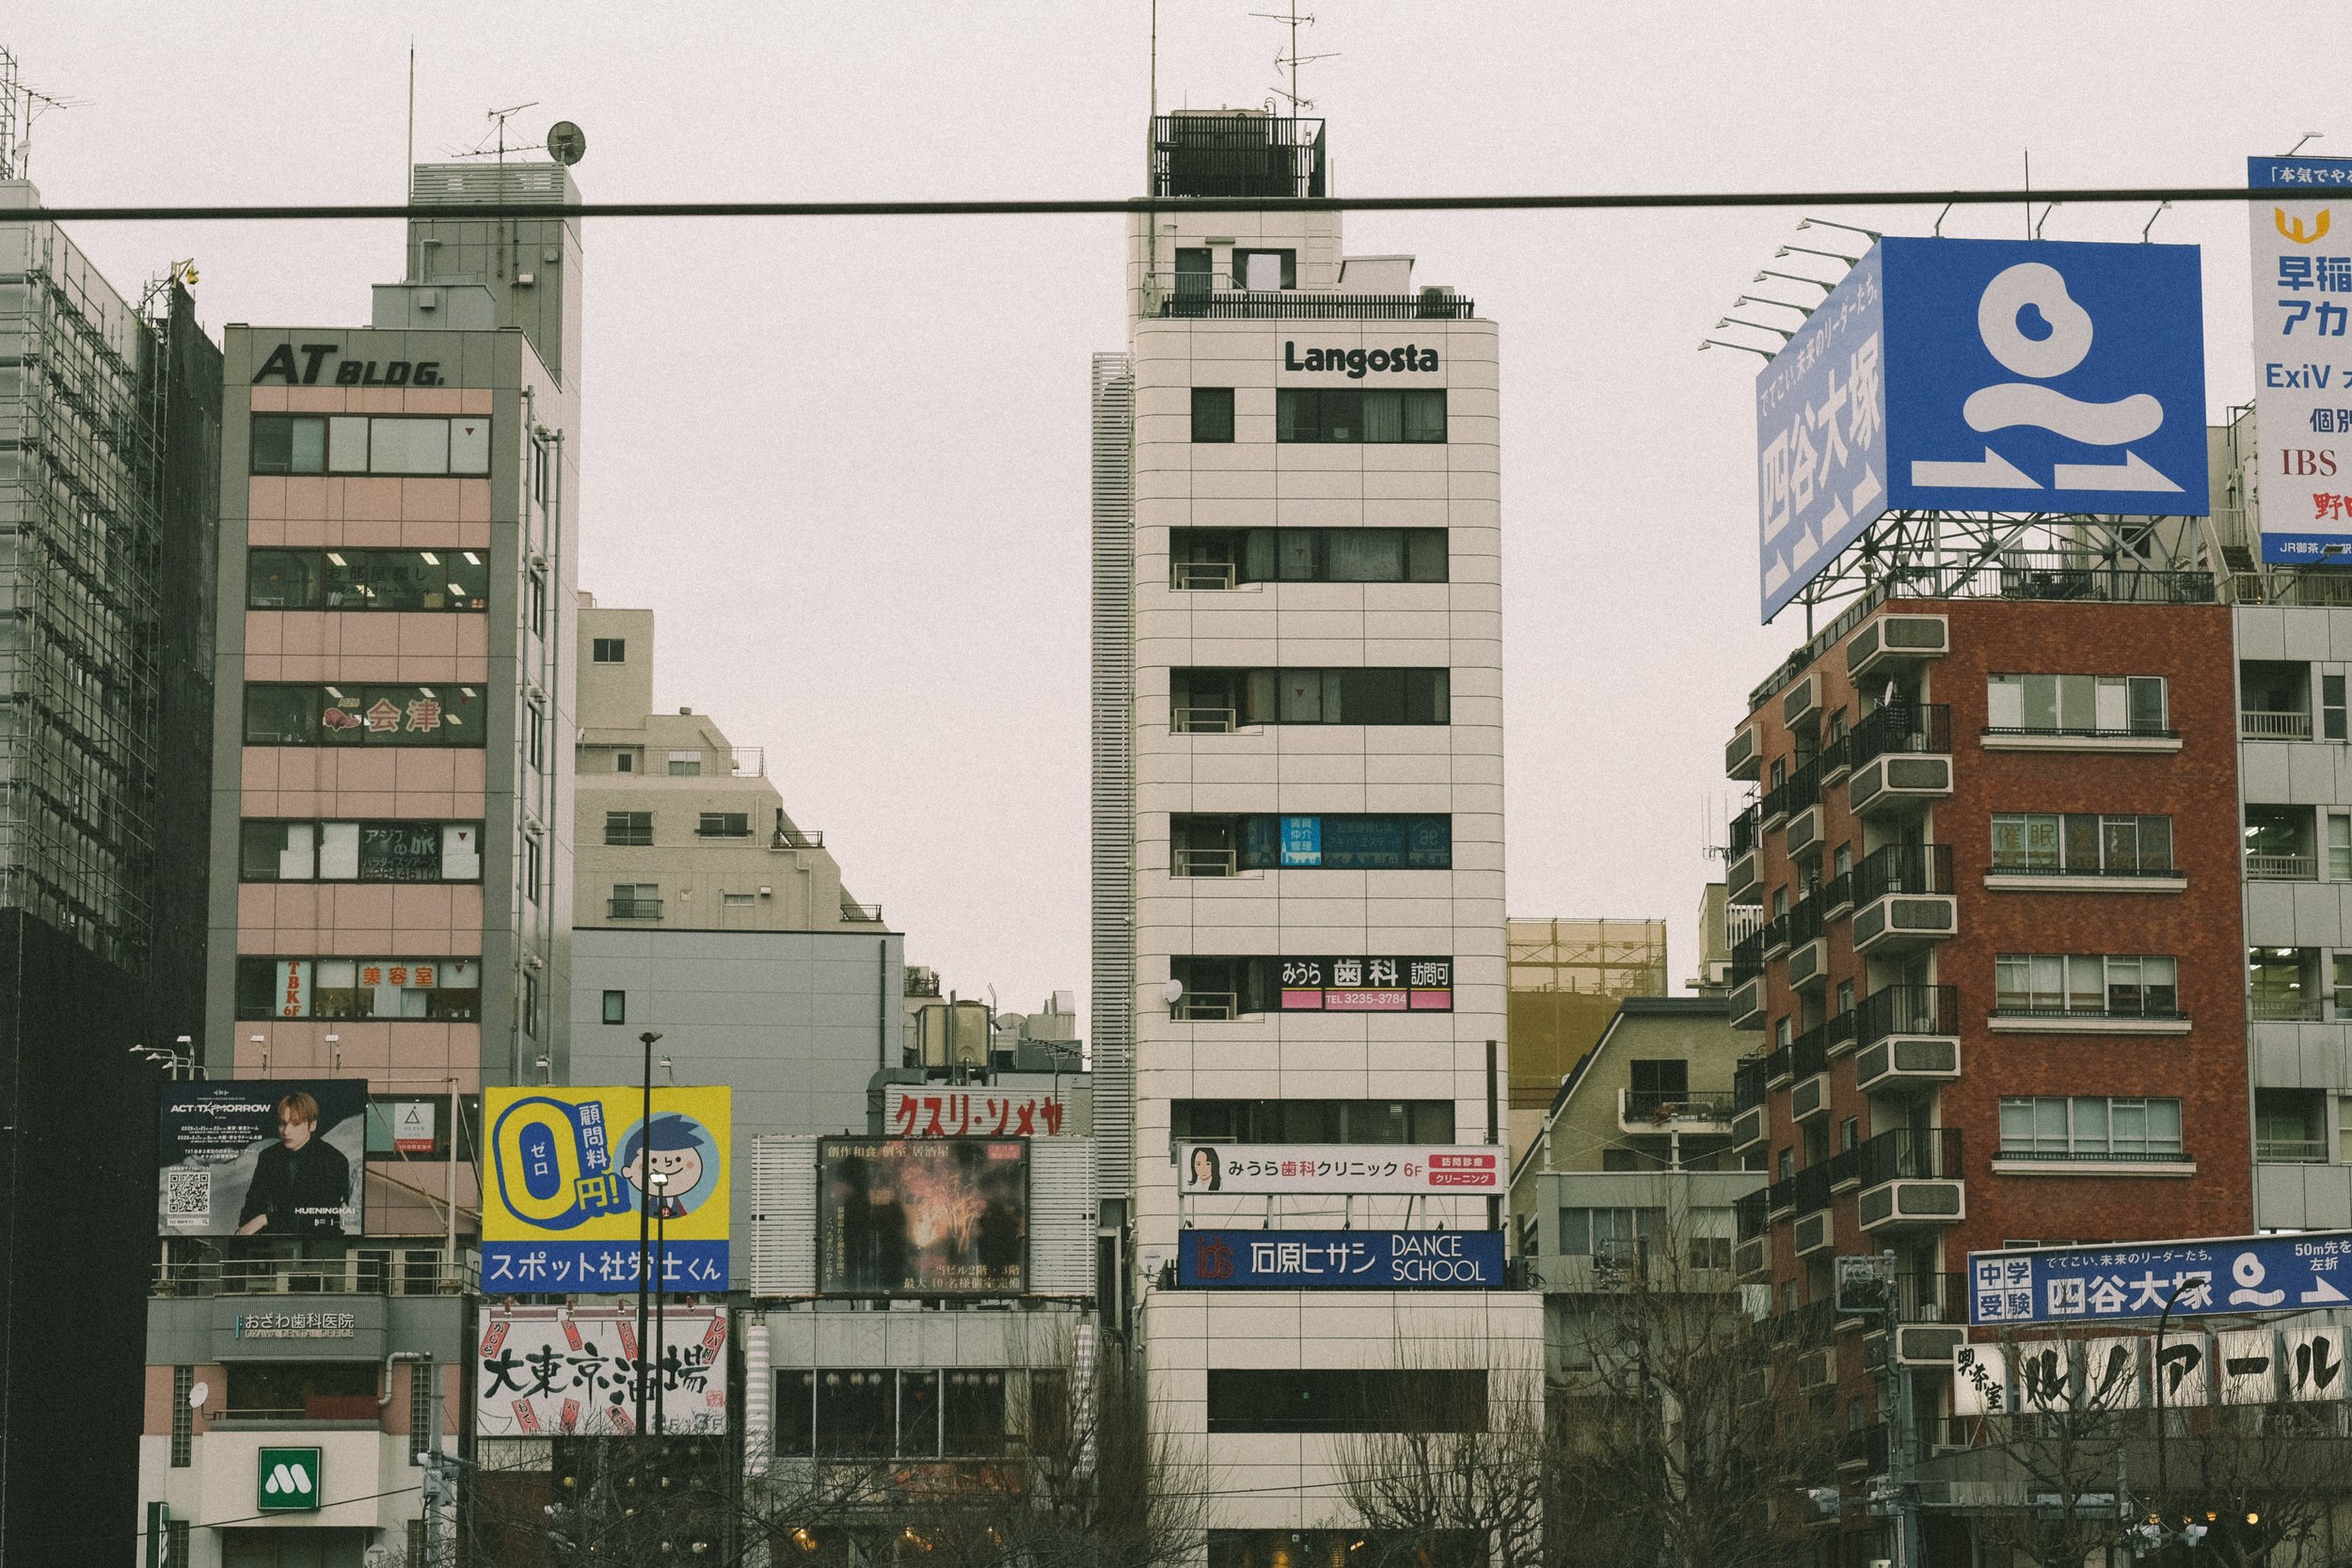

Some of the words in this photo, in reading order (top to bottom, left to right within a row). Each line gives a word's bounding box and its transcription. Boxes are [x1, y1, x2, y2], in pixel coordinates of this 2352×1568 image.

[2278, 256, 2352, 293] 早稲
[2278, 300, 2348, 337] アカ
[252, 343, 340, 385] AT
[335, 360, 445, 386] BLDG.
[1284, 341, 1439, 379] Langosta
[2265, 363, 2331, 389] ExiV
[1762, 330, 1881, 546] 四谷大塚
[2280, 449, 2338, 477] IBS
[2280, 543, 2352, 555] JR御茶駅
[366, 698, 441, 733] 会津
[363, 967, 434, 987] 美容室
[1282, 961, 1321, 985] みうら
[1333, 958, 1399, 987] 歯科
[1410, 962, 1449, 986] 訪問可
[283, 1005, 301, 1016] 6F
[1326, 994, 1343, 1004] TEL
[1343, 993, 1407, 1005] 3235-3784
[896, 1094, 1063, 1136] クスリ・ソメヤ
[579, 1104, 607, 1169] 顧問料
[531, 1142, 548, 1176] ゼロ
[828, 1146, 877, 1158] 創作和食
[883, 1145, 907, 1157] 個室
[912, 1145, 949, 1157] 居酒屋
[1441, 1157, 1484, 1167] 訪問診療
[1228, 1160, 1398, 1177] みうら歯科クリニック
[1404, 1163, 1422, 1177] 6F
[1436, 1173, 1489, 1184] クリーニング
[1250, 1242, 1375, 1275] 石原ヒサシ
[1391, 1234, 1462, 1258] DANCE
[2046, 1248, 2213, 1269] でてこい、未来のリーダーたち。
[2295, 1240, 2352, 1257] 50m先を
[490, 1251, 722, 1282] スポット社労士くん
[1391, 1259, 1486, 1282] SCHOOL
[1979, 1261, 2030, 1286] 中学
[2310, 1257, 2339, 1271] 左折
[1979, 1292, 2032, 1318] 受験
[2047, 1270, 2214, 1315] 四谷大塚
[245, 1312, 355, 1329] おざわ歯科医院
[245, 1329, 277, 1338] OZAWA
[280, 1329, 313, 1338] DENTAL
[321, 1329, 355, 1338] OFFICE
[484, 1322, 505, 1356] かしら
[2026, 1335, 2342, 1404] ルノアール
